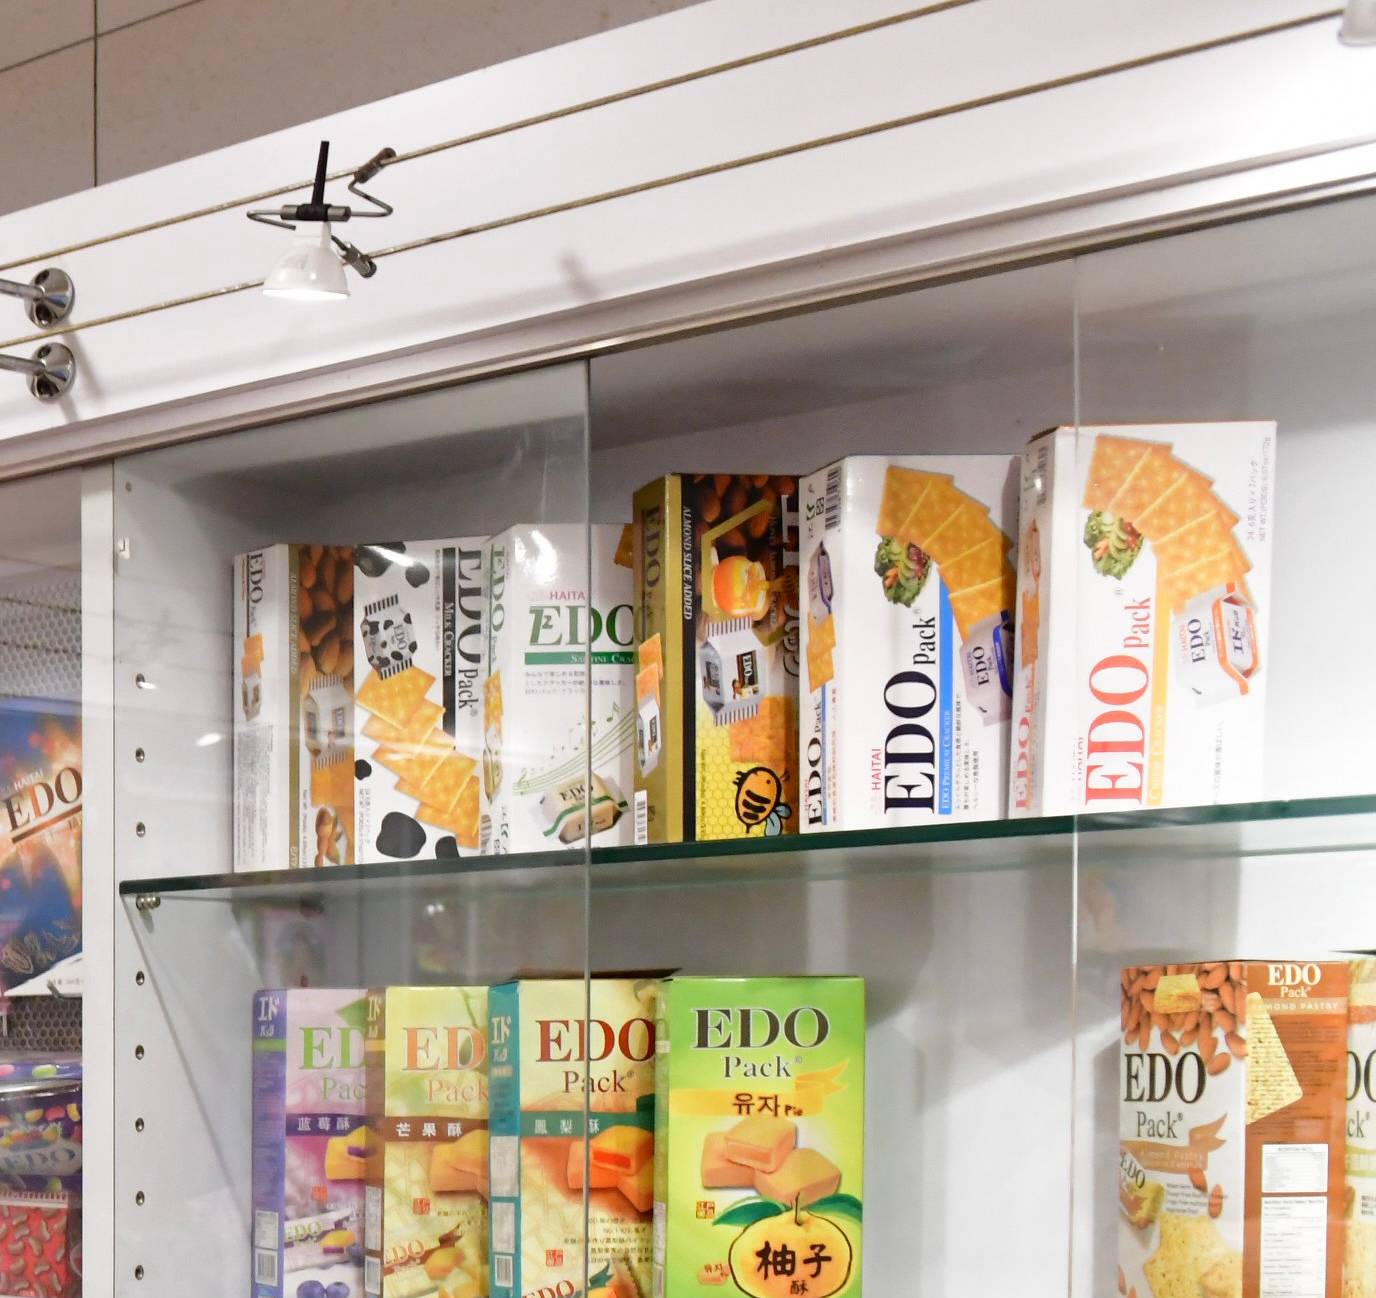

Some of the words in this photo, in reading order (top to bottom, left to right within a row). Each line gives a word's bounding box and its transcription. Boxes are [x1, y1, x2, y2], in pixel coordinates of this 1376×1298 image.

[682, 506, 693, 549] ALMOND
[247, 550, 264, 603] EDO
[683, 551, 693, 580] SLICE
[456, 546, 482, 664] EDO
[491, 545, 506, 634] EDO
[549, 590, 586, 602] HAITA
[684, 582, 693, 621] ADDED
[528, 603, 634, 647] EDO
[1186, 617, 1207, 664] EDO
[972, 645, 990, 687] EDO
[457, 668, 479, 710] Pack
[1084, 654, 1150, 807] EDO
[1122, 596, 1153, 650] Pack
[813, 702, 823, 735] Pack
[883, 670, 937, 816] EDO
[911, 616, 937, 666] Pack
[807, 736, 823, 826] EDO
[871, 748, 882, 792] HAITAI
[1014, 715, 1031, 809] EDO
[2, 767, 83, 832] EDO
[1266, 963, 1322, 988] EDO
[1279, 985, 1310, 999] Pack
[1299, 1001, 1340, 1011] PASTRY
[298, 1025, 367, 1071] ED
[401, 1025, 487, 1072] ED
[535, 1017, 655, 1063] EDO
[692, 1006, 830, 1051] EDO
[320, 1076, 366, 1102] Pac
[426, 1078, 489, 1103] Pack
[1123, 1051, 1207, 1104] EDO
[732, 1091, 781, 1120] 유자
[783, 1103, 805, 1118] Pie
[395, 1121, 464, 1139] 芒果酥
[533, 1119, 601, 1136] 鳳梨酥
[2, 1148, 77, 1174] EDO
[1119, 1153, 1147, 1190] EDO
[284, 1221, 323, 1243] EDO
[384, 1238, 426, 1264] EDO
[755, 1240, 833, 1281] 柚子
[789, 1278, 809, 1296] 酥
